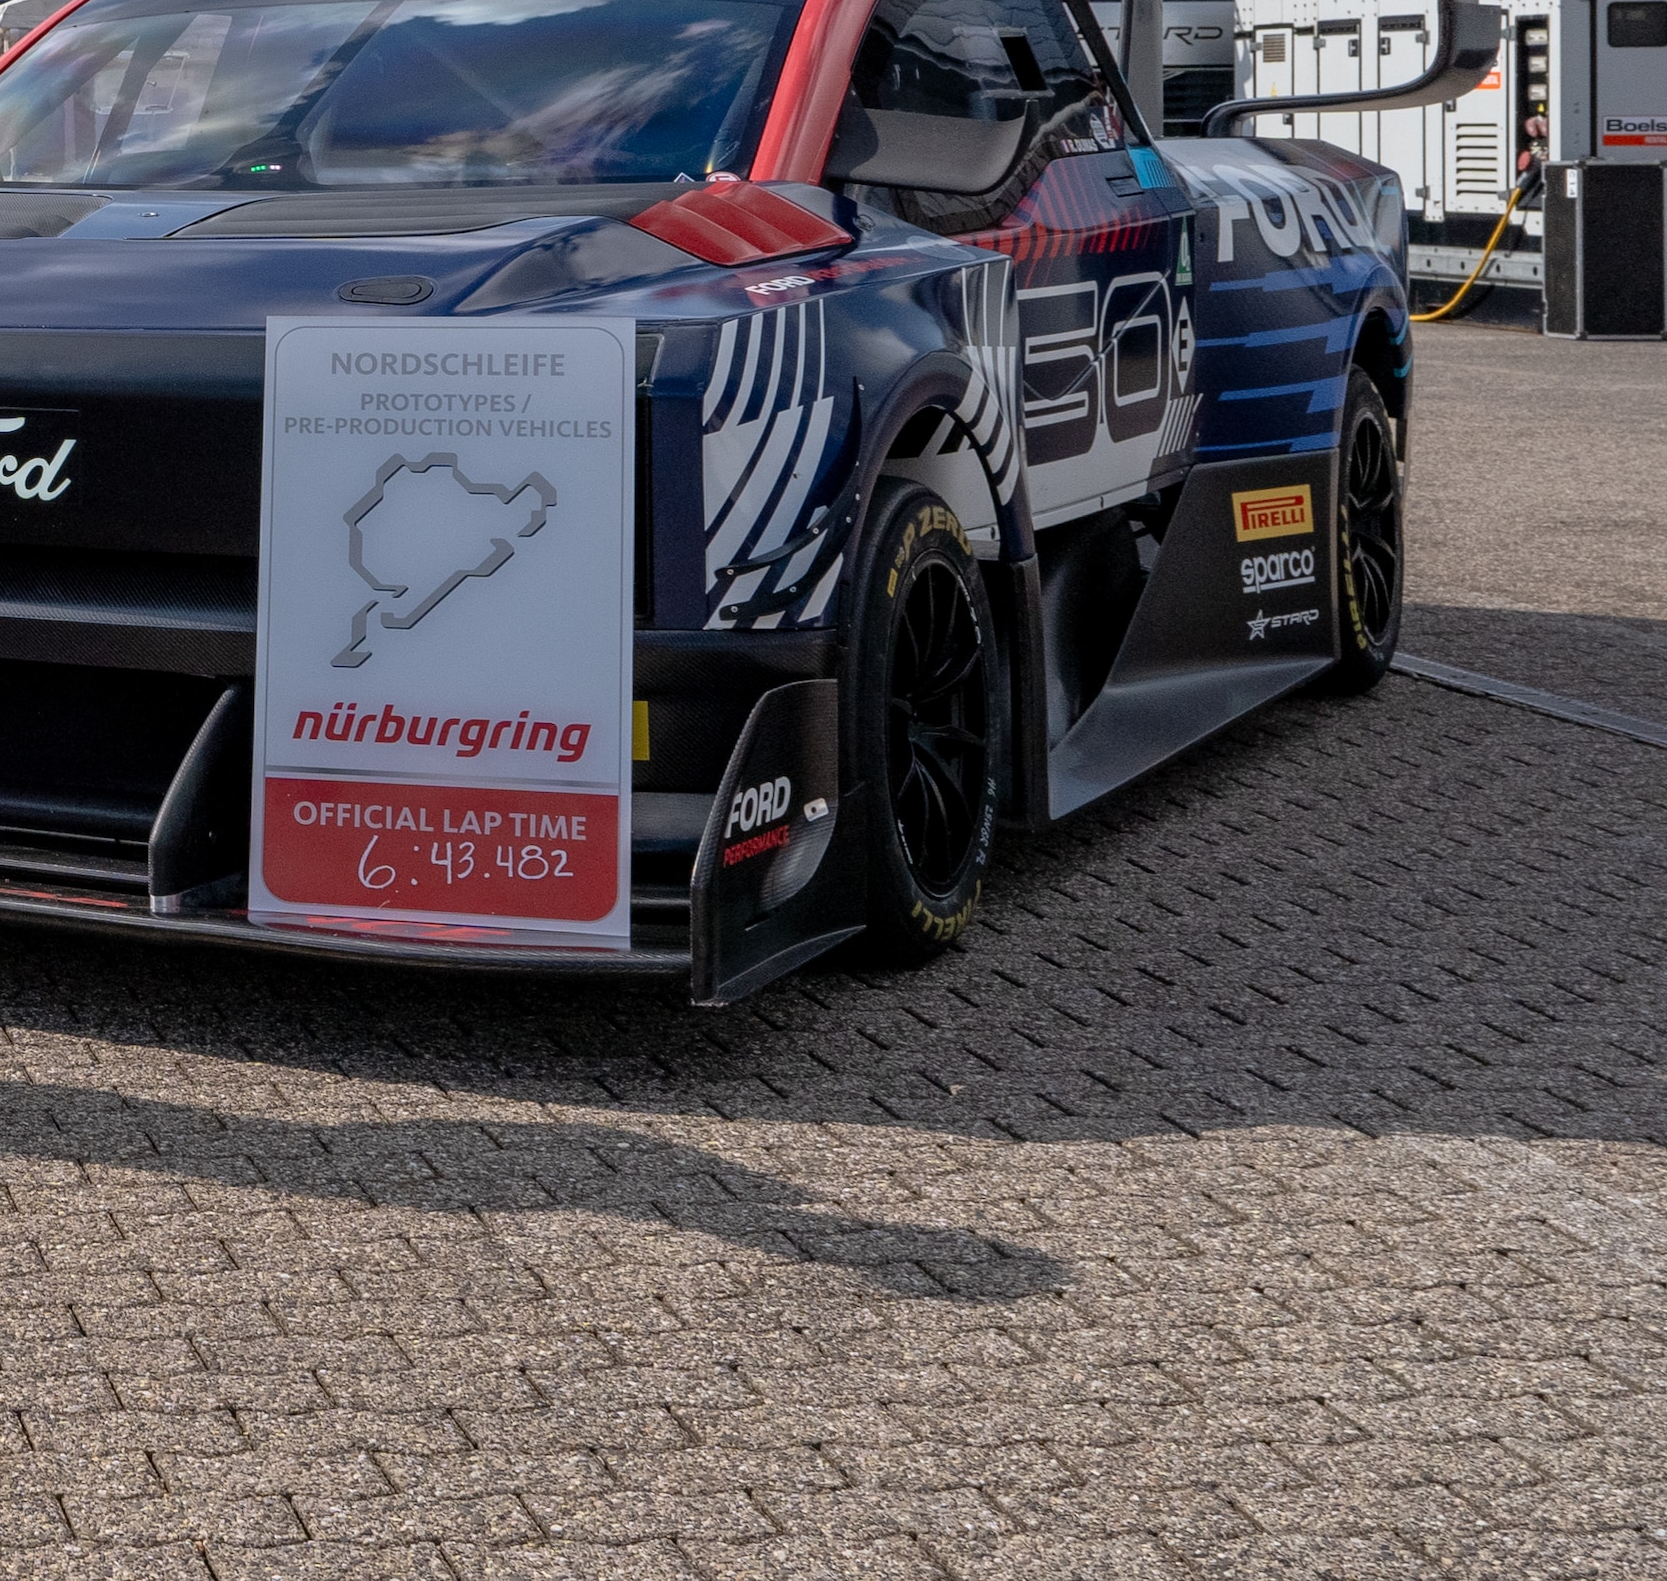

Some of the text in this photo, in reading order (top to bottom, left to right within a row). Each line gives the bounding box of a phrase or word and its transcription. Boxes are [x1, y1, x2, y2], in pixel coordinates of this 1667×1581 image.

[745, 275, 816, 295] FORD
[330, 352, 565, 376] NORDSCHLEIFE
[1178, 319, 1187, 371] E
[360, 393, 515, 413] PROTOTYPES
[284, 417, 612, 438] PRE-PRODUCTION VEHICLES
[1240, 495, 1305, 531] PIRELLI
[1241, 549, 1315, 594] sparco
[292, 702, 591, 762] nürburgring
[293, 801, 587, 841] OFFICIAL LAP TIME
[724, 776, 791, 838] FORD
[357, 835, 574, 889] 6:43.482
